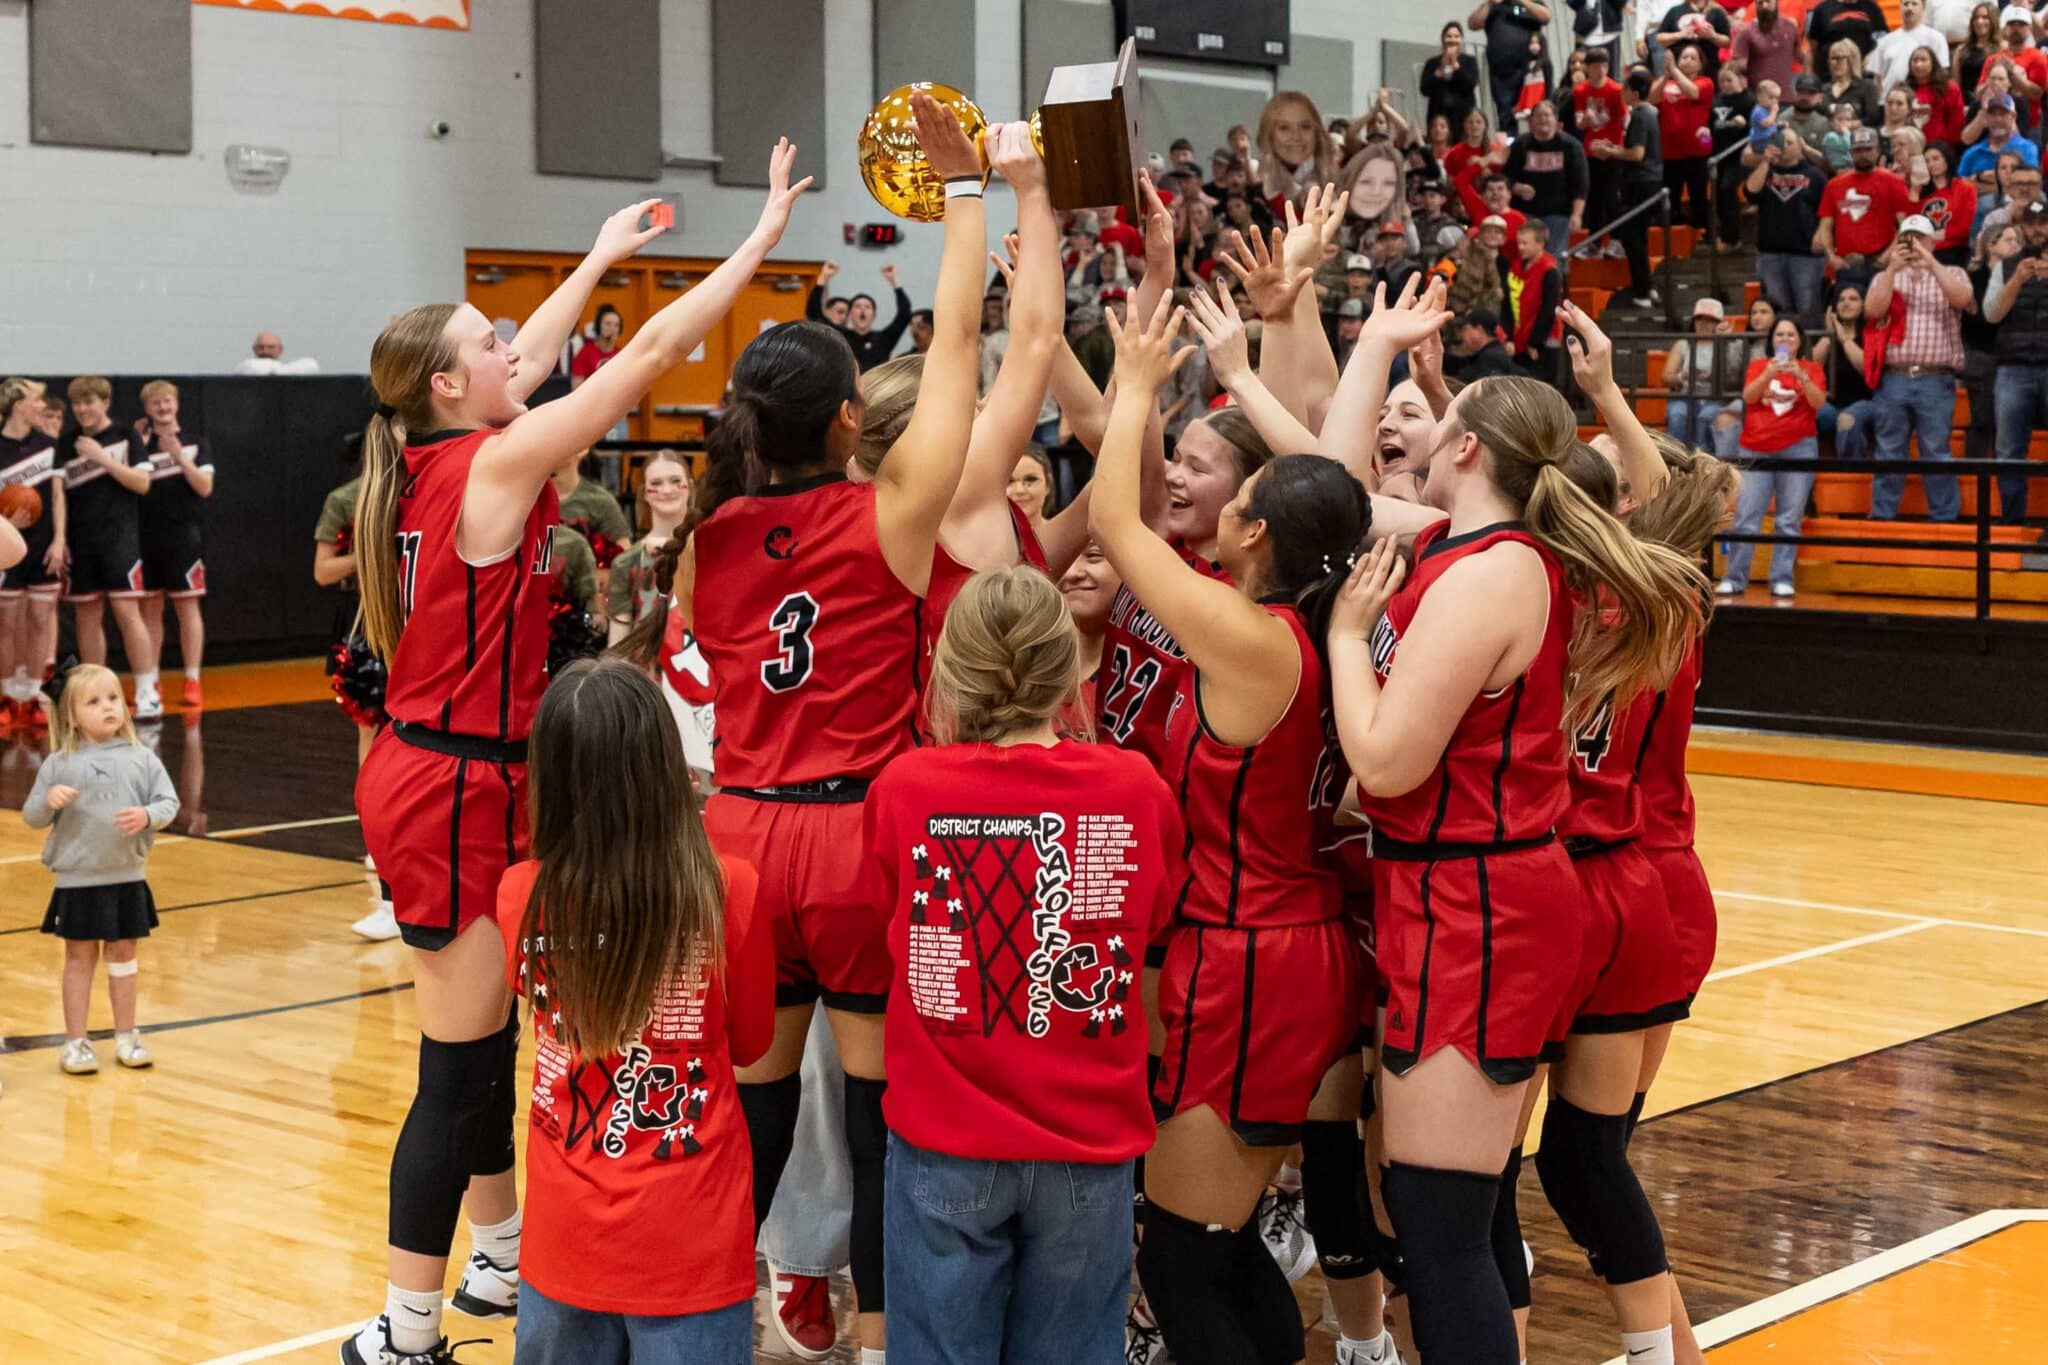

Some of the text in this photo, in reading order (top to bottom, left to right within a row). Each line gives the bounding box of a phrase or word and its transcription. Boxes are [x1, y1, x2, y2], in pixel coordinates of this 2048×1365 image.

[760, 590, 821, 694] 3
[929, 818, 1033, 836] DISTRICT CHAMPS
[1025, 812, 1072, 982] PLAYOFFS
